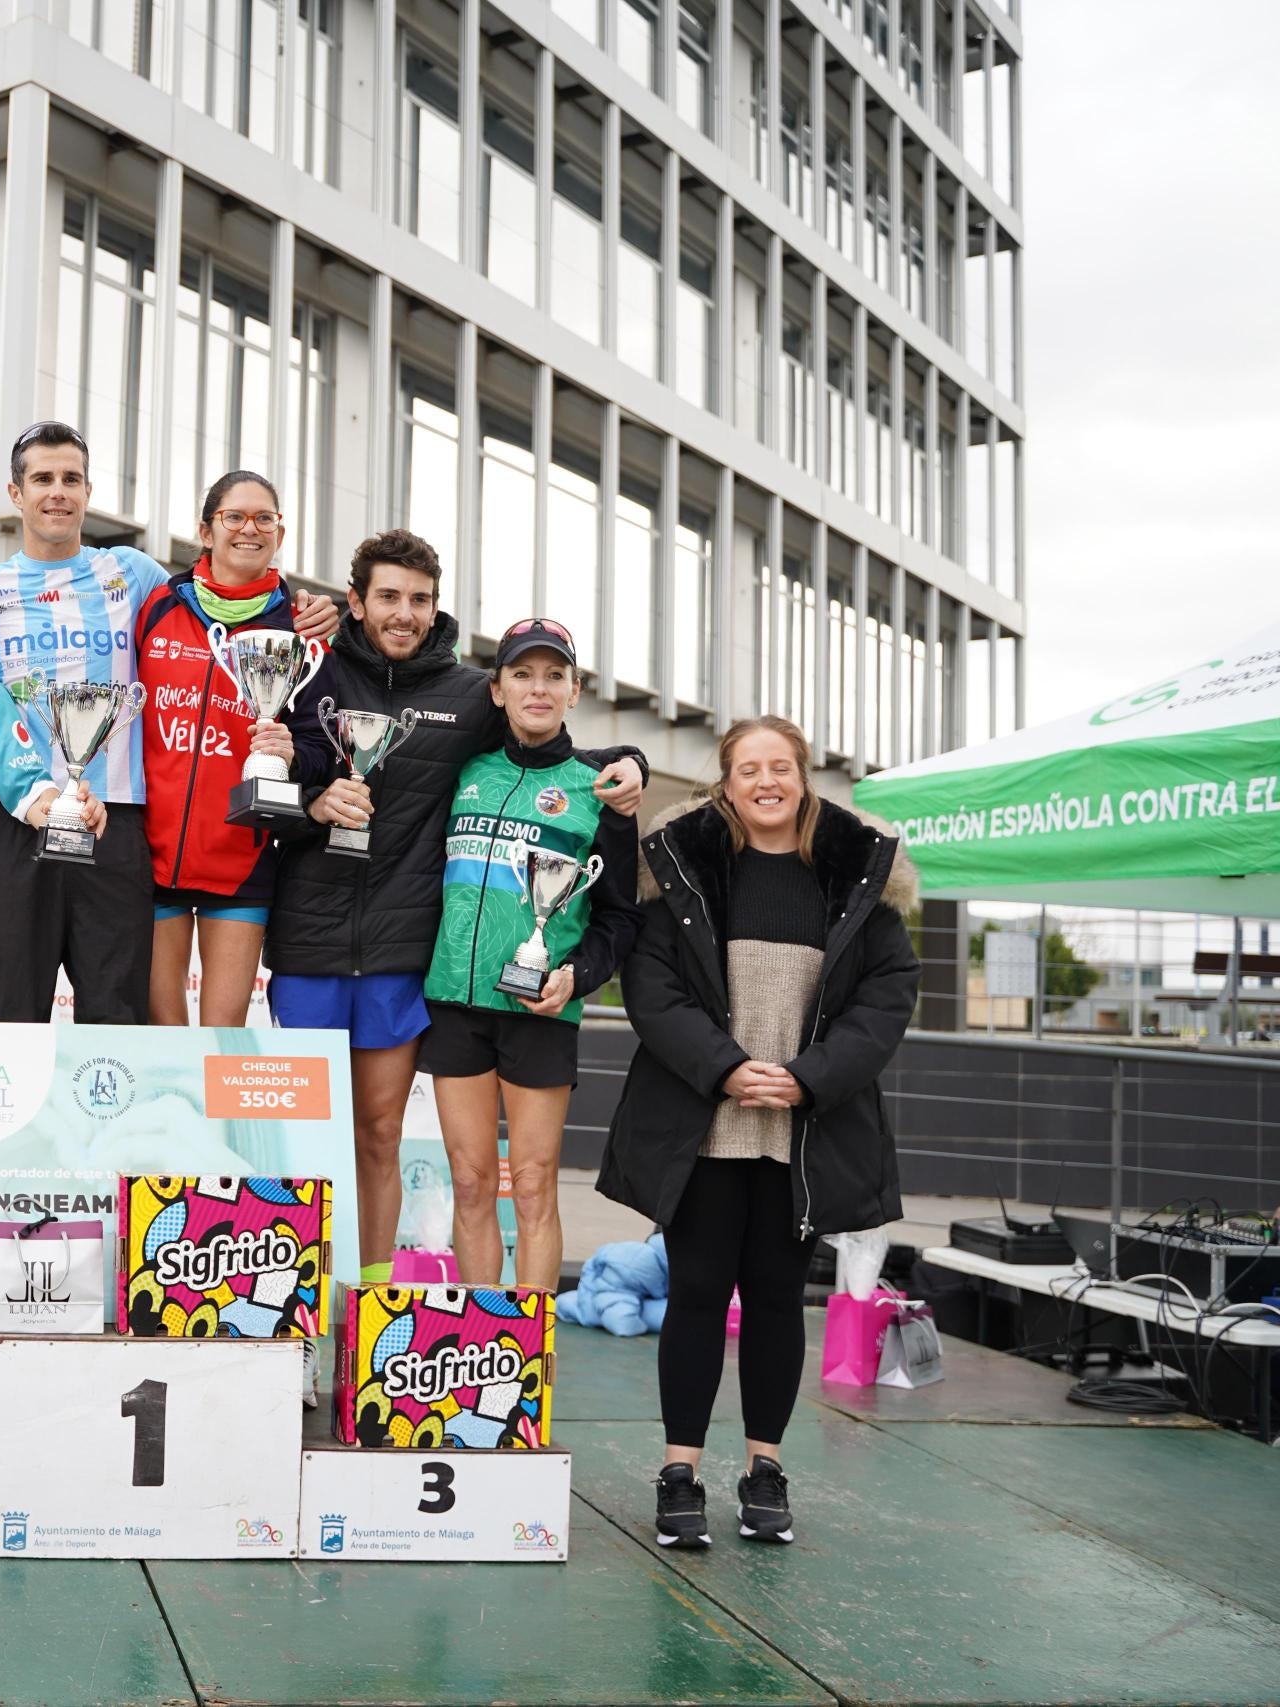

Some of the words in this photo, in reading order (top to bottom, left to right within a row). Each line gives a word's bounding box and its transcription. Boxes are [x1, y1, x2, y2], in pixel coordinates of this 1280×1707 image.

[422, 710, 457, 722] TERREX
[989, 792, 1114, 839] ESPAÑOLA
[1119, 780, 1238, 825] CONTRA
[454, 816, 541, 842] ATLETISMO
[93, 1057, 106, 1065] FOR
[107, 1057, 135, 1083] HERCULES
[242, 1062, 292, 1073] CHEQUE
[222, 1075, 290, 1087] VALORADO
[293, 1077, 309, 1087] EN
[239, 1091, 297, 1109] 350€
[54, 1167, 71, 1179] de
[74, 1170, 105, 1179] este
[160, 1231, 295, 1286] Sigfrido
[388, 1345, 519, 1399] Sigfrido
[121, 1379, 168, 1487] 1
[417, 1462, 457, 1514] 3
[34, 1525, 106, 1537] Ayuntamiento
[109, 1527, 121, 1536] de
[124, 1526, 161, 1538] Málaga
[351, 1527, 421, 1540] Ayuntamiento
[423, 1529, 436, 1538] de
[438, 1529, 475, 1540] Málaga
[65, 1540, 97, 1549] Deporte
[351, 1542, 369, 1550] Área
[372, 1542, 382, 1550] de
[385, 1542, 412, 1551] Deporte
